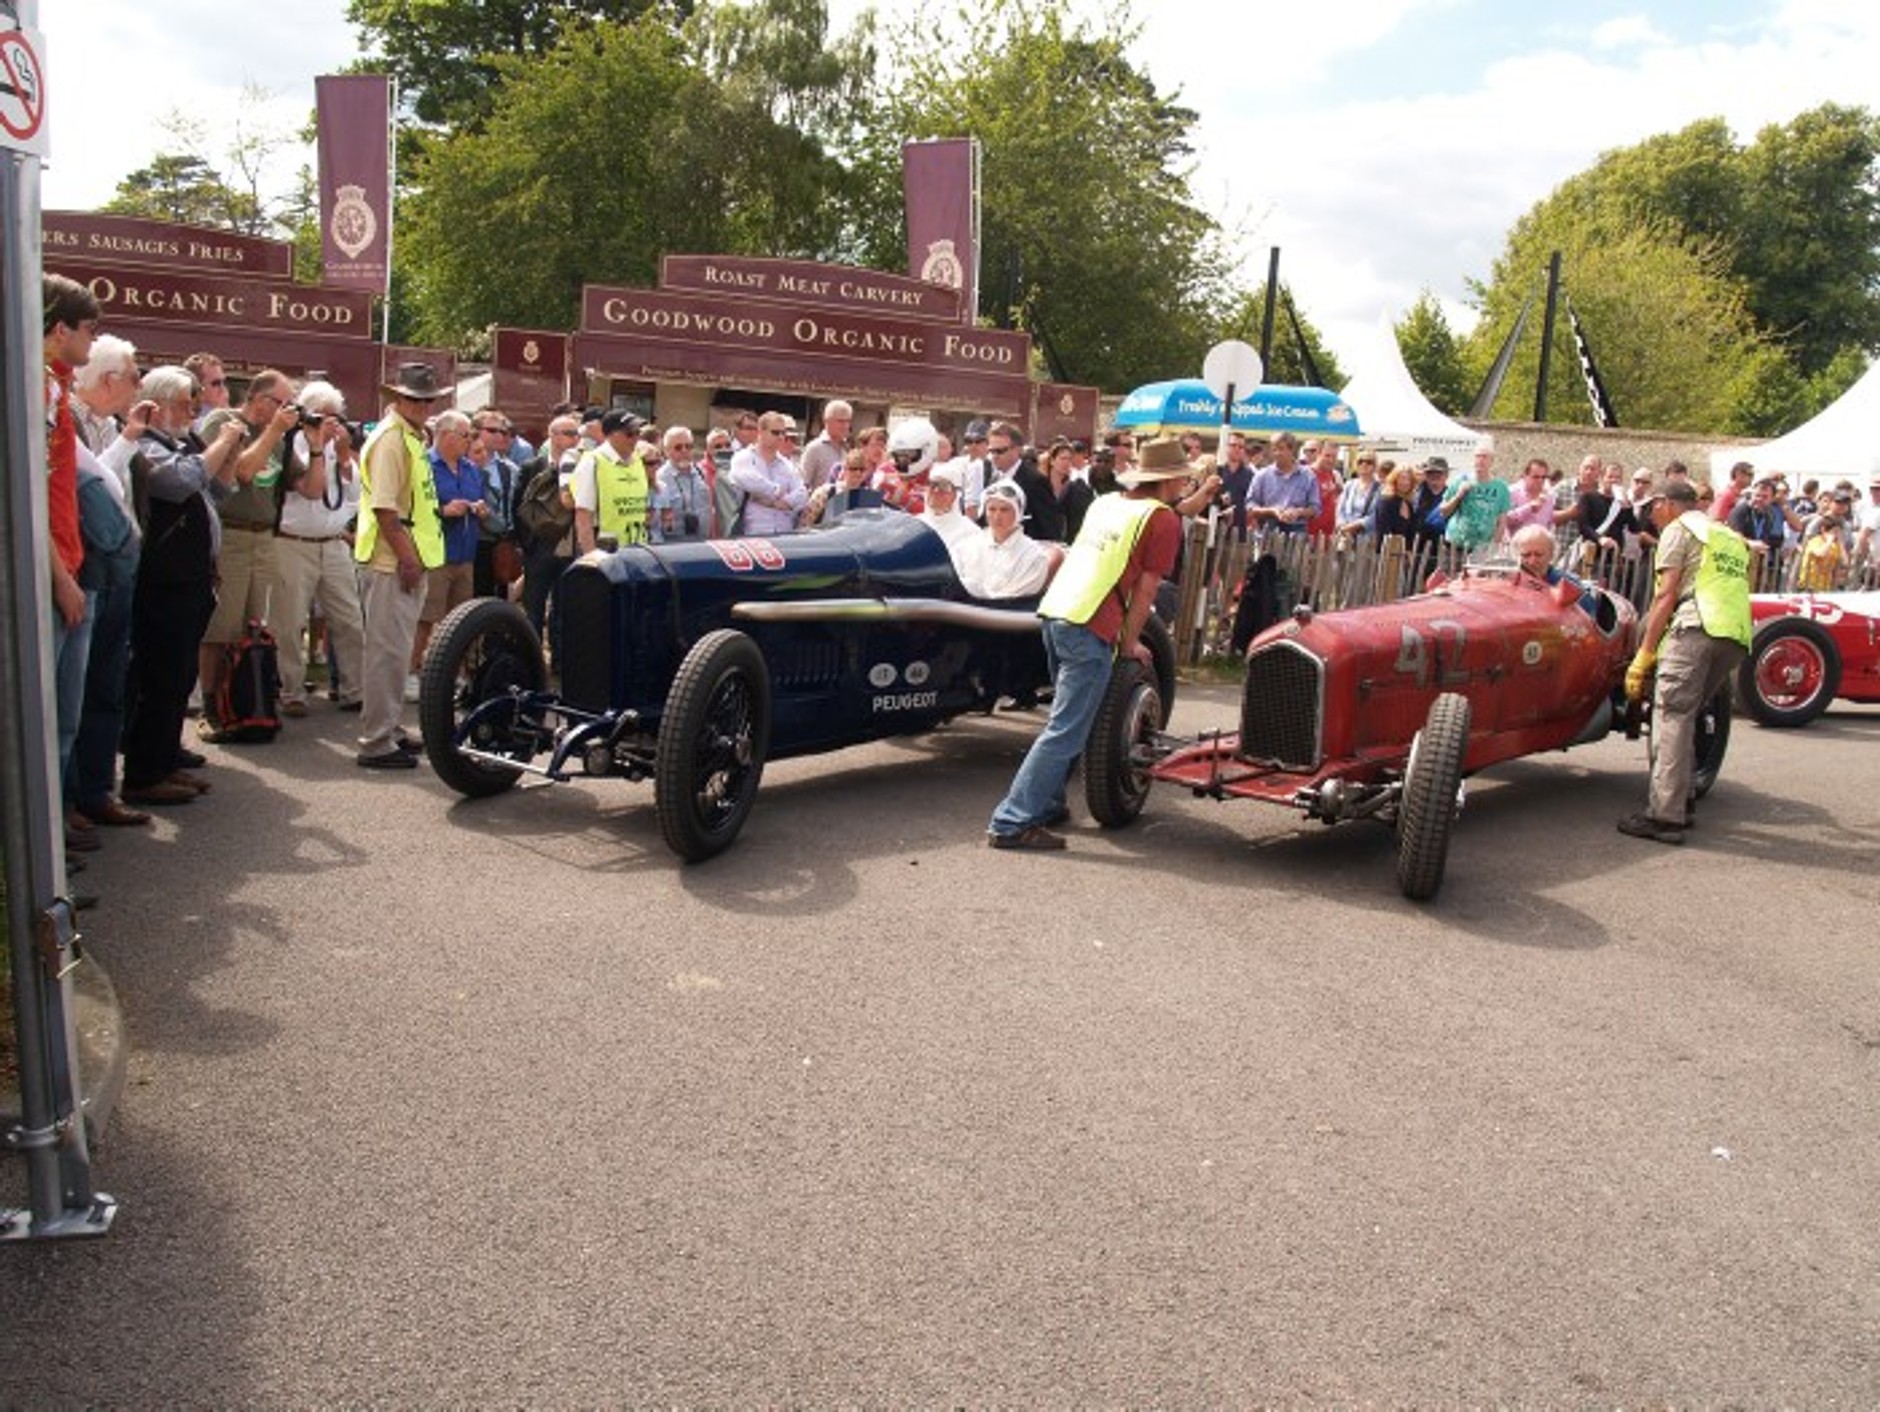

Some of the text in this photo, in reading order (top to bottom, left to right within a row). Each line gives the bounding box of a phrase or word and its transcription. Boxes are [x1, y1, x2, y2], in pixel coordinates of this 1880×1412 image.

[88, 233, 179, 257] SAUSAGES
[188, 243, 244, 262] FRIES
[88, 276, 352, 324] ORGANIC FOOD
[705, 266, 923, 305] ROAST MEAT CARVERY
[603, 298, 1012, 364] GOODWOOD ORGANIC FOOD
[1394, 619, 1470, 688] 42
[872, 691, 938, 713] PEUGEOT
